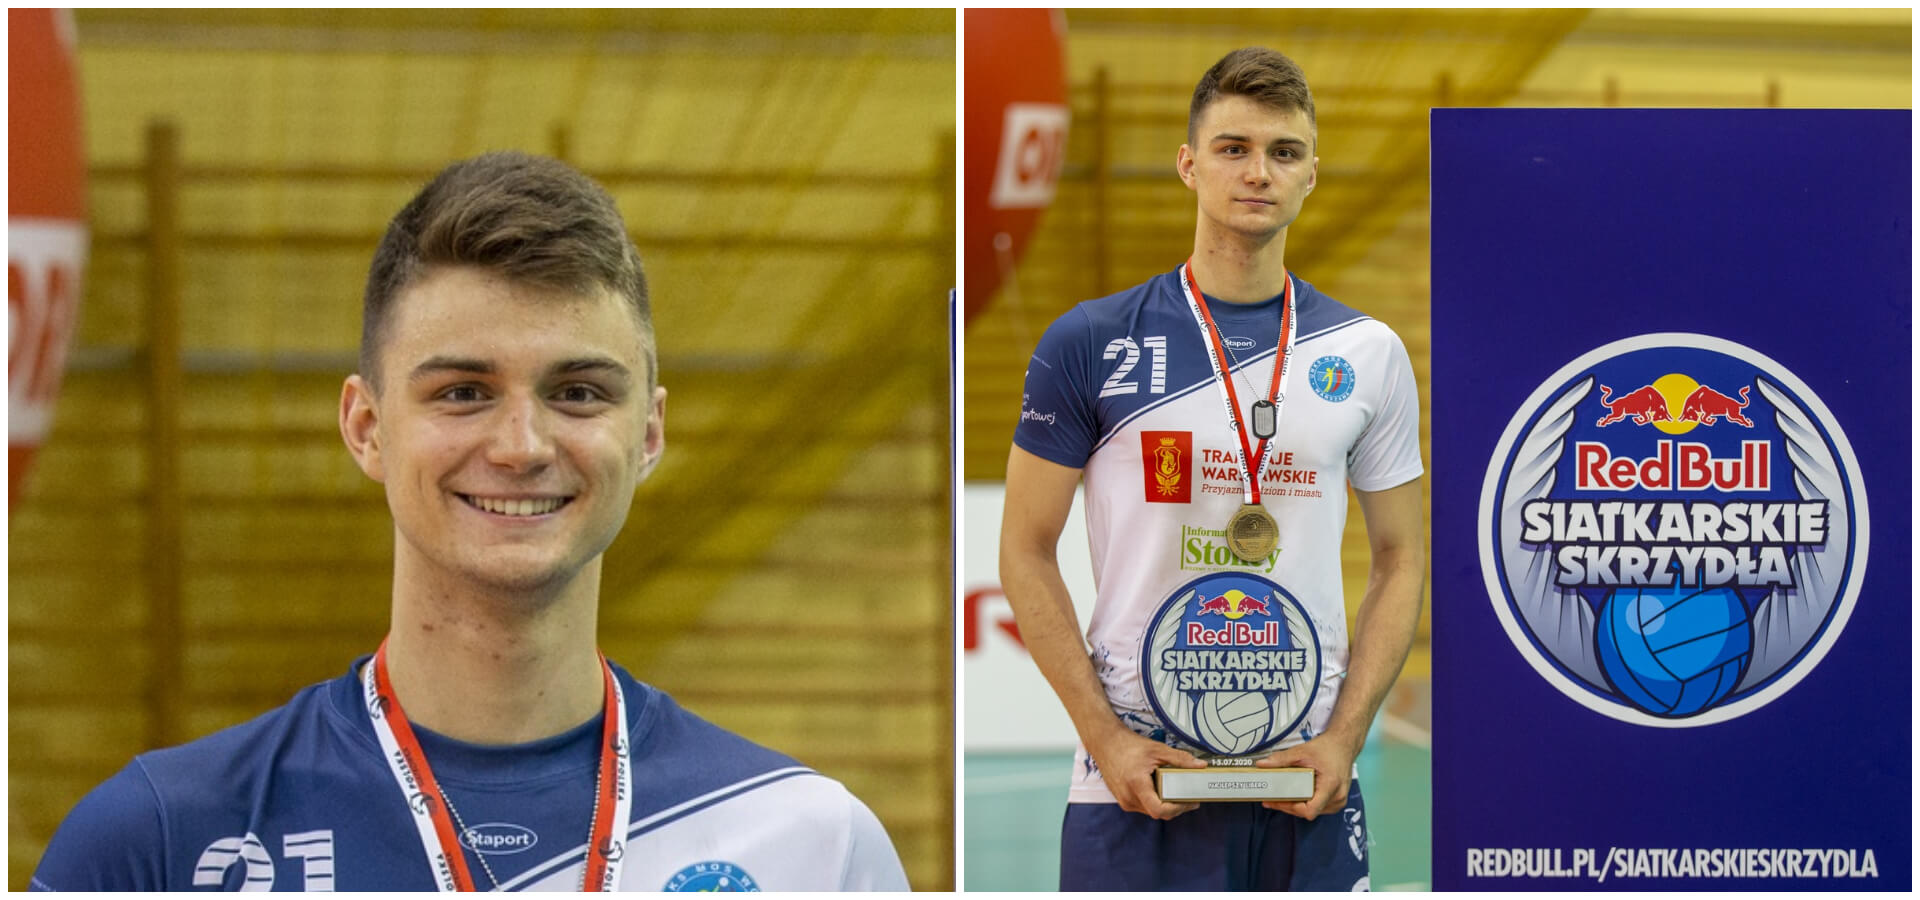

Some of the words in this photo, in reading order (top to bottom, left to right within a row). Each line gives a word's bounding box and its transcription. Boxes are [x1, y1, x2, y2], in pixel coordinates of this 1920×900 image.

[1225, 337, 1253, 348] Staport
[1099, 336, 1167, 398] 21
[1021, 408, 1056, 424] portowej
[1202, 449, 1294, 466] TRAAJE
[1576, 440, 1672, 490] Red
[1677, 440, 1771, 490] Bull
[1202, 467, 1318, 484] WARSAWSKIE
[1187, 526, 1228, 537] Informa
[1522, 501, 1829, 544] SIATKARSKIE
[1186, 537, 1282, 574] Stoy
[1558, 546, 1795, 586] SKRZYDŁA
[1187, 621, 1232, 646] Red
[1235, 621, 1279, 646] Bull
[1163, 651, 1305, 671] SIATKARSKIE
[1179, 671, 1290, 691] SKRZYDŁA
[465, 830, 530, 848] Staport
[437, 853, 455, 892] OLSKA
[1466, 847, 1879, 882] REDBULL.PL/SIATKARSKIESKRZYDLA
